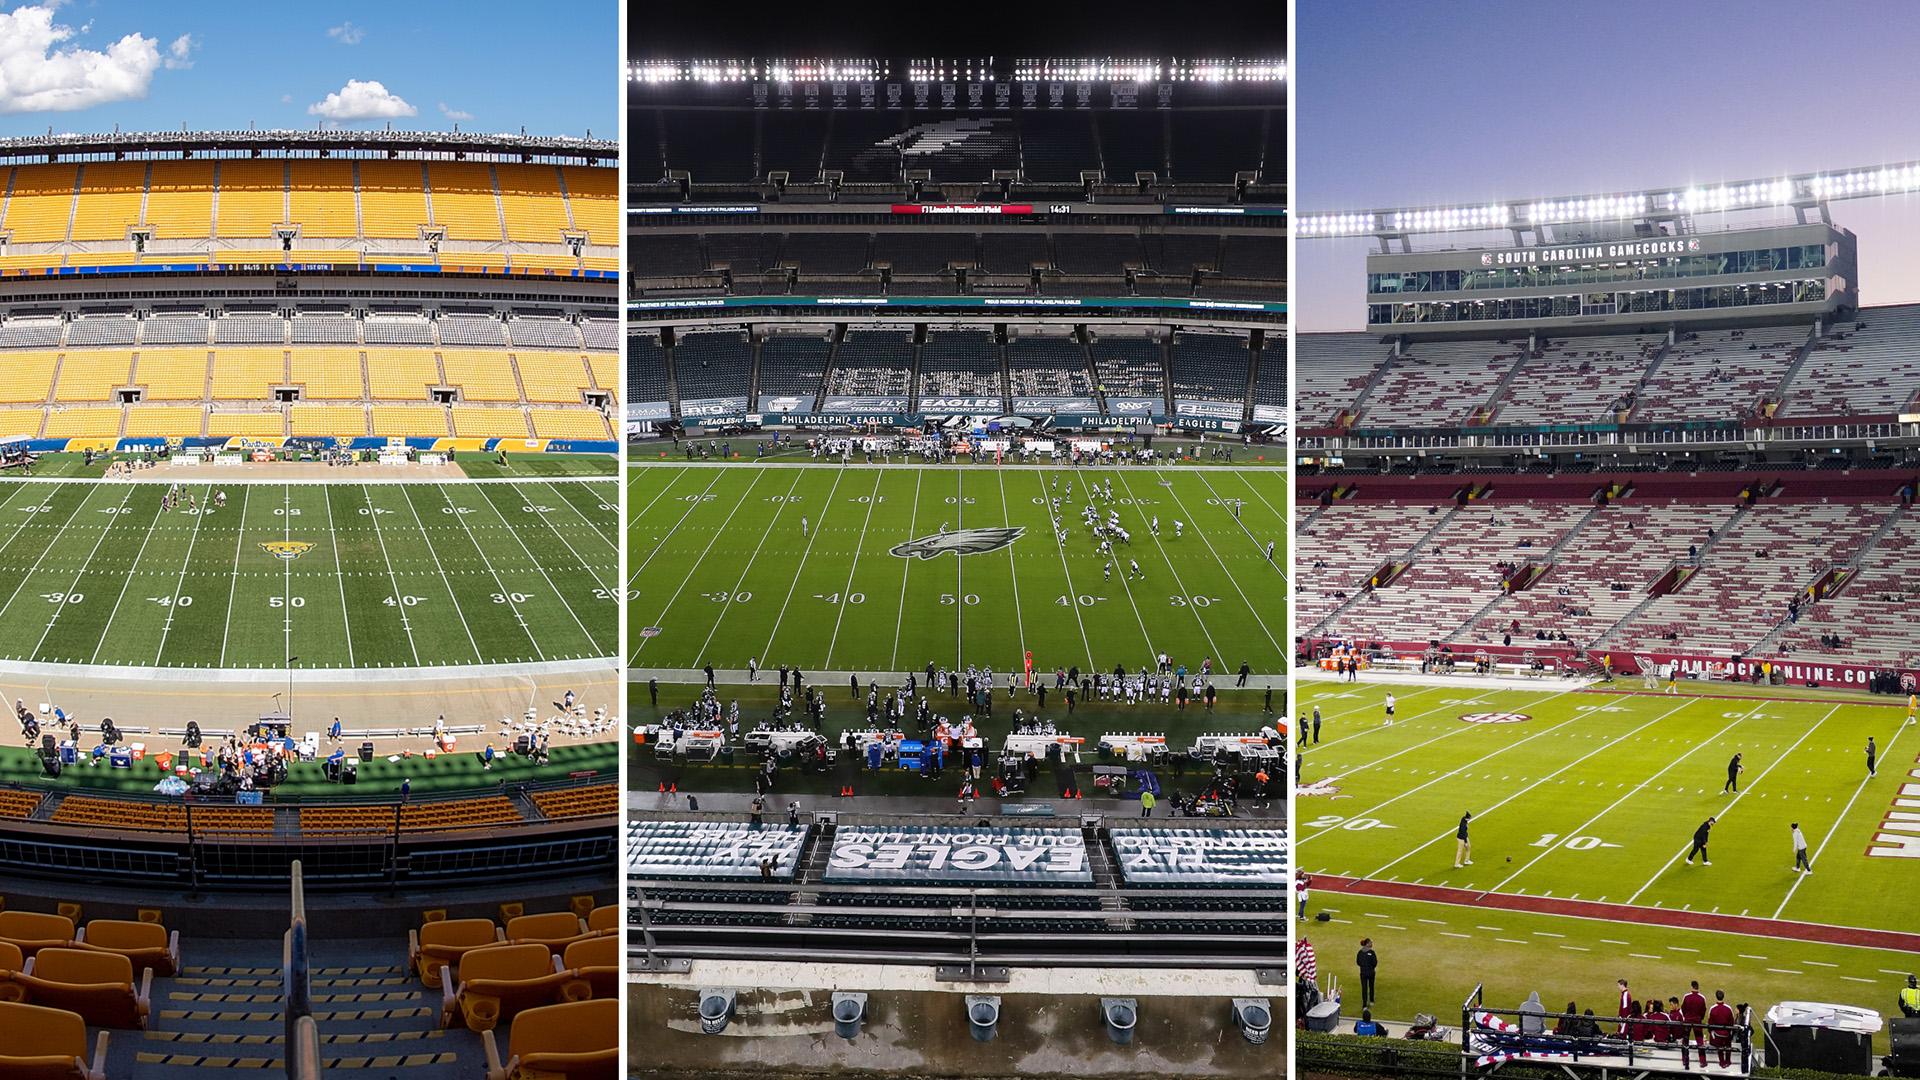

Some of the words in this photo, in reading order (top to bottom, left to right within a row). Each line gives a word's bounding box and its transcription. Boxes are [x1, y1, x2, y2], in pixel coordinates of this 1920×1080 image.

[929, 205, 953, 213] Lincoln
[954, 205, 982, 213] Financial
[984, 205, 1001, 213] Field
[1050, 205, 1070, 213] 14:31
[1497, 252, 1536, 264] SOUTH
[1543, 247, 1603, 262] CAROLINA
[1609, 240, 1685, 257] GAMECOCKS
[920, 399, 999, 407] EAGLES
[781, 416, 851, 424] PHILADELPHIA
[857, 416, 894, 424] EAGLES
[1081, 417, 1153, 425] PHILADELPHIA
[1178, 418, 1217, 428] EAGLES
[240, 437, 276, 448] Panthers
[273, 508, 301, 516] 50
[48, 592, 85, 604] 30
[155, 596, 194, 608] 40
[269, 596, 306, 608] 50
[382, 595, 418, 607] 40
[490, 592, 527, 604] 30
[711, 591, 753, 603] 30
[823, 592, 866, 604] 40
[939, 593, 981, 606] 50
[1055, 594, 1096, 607] 40
[1169, 594, 1213, 607] 30
[1301, 815, 1382, 831] 20
[841, 832, 902, 845] LINE
[911, 833, 1007, 846] FRONT
[1020, 835, 1084, 847] OUR
[1529, 833, 1603, 850] 10
[830, 845, 1086, 872] EAGLES
[1126, 847, 1207, 866] FLY
